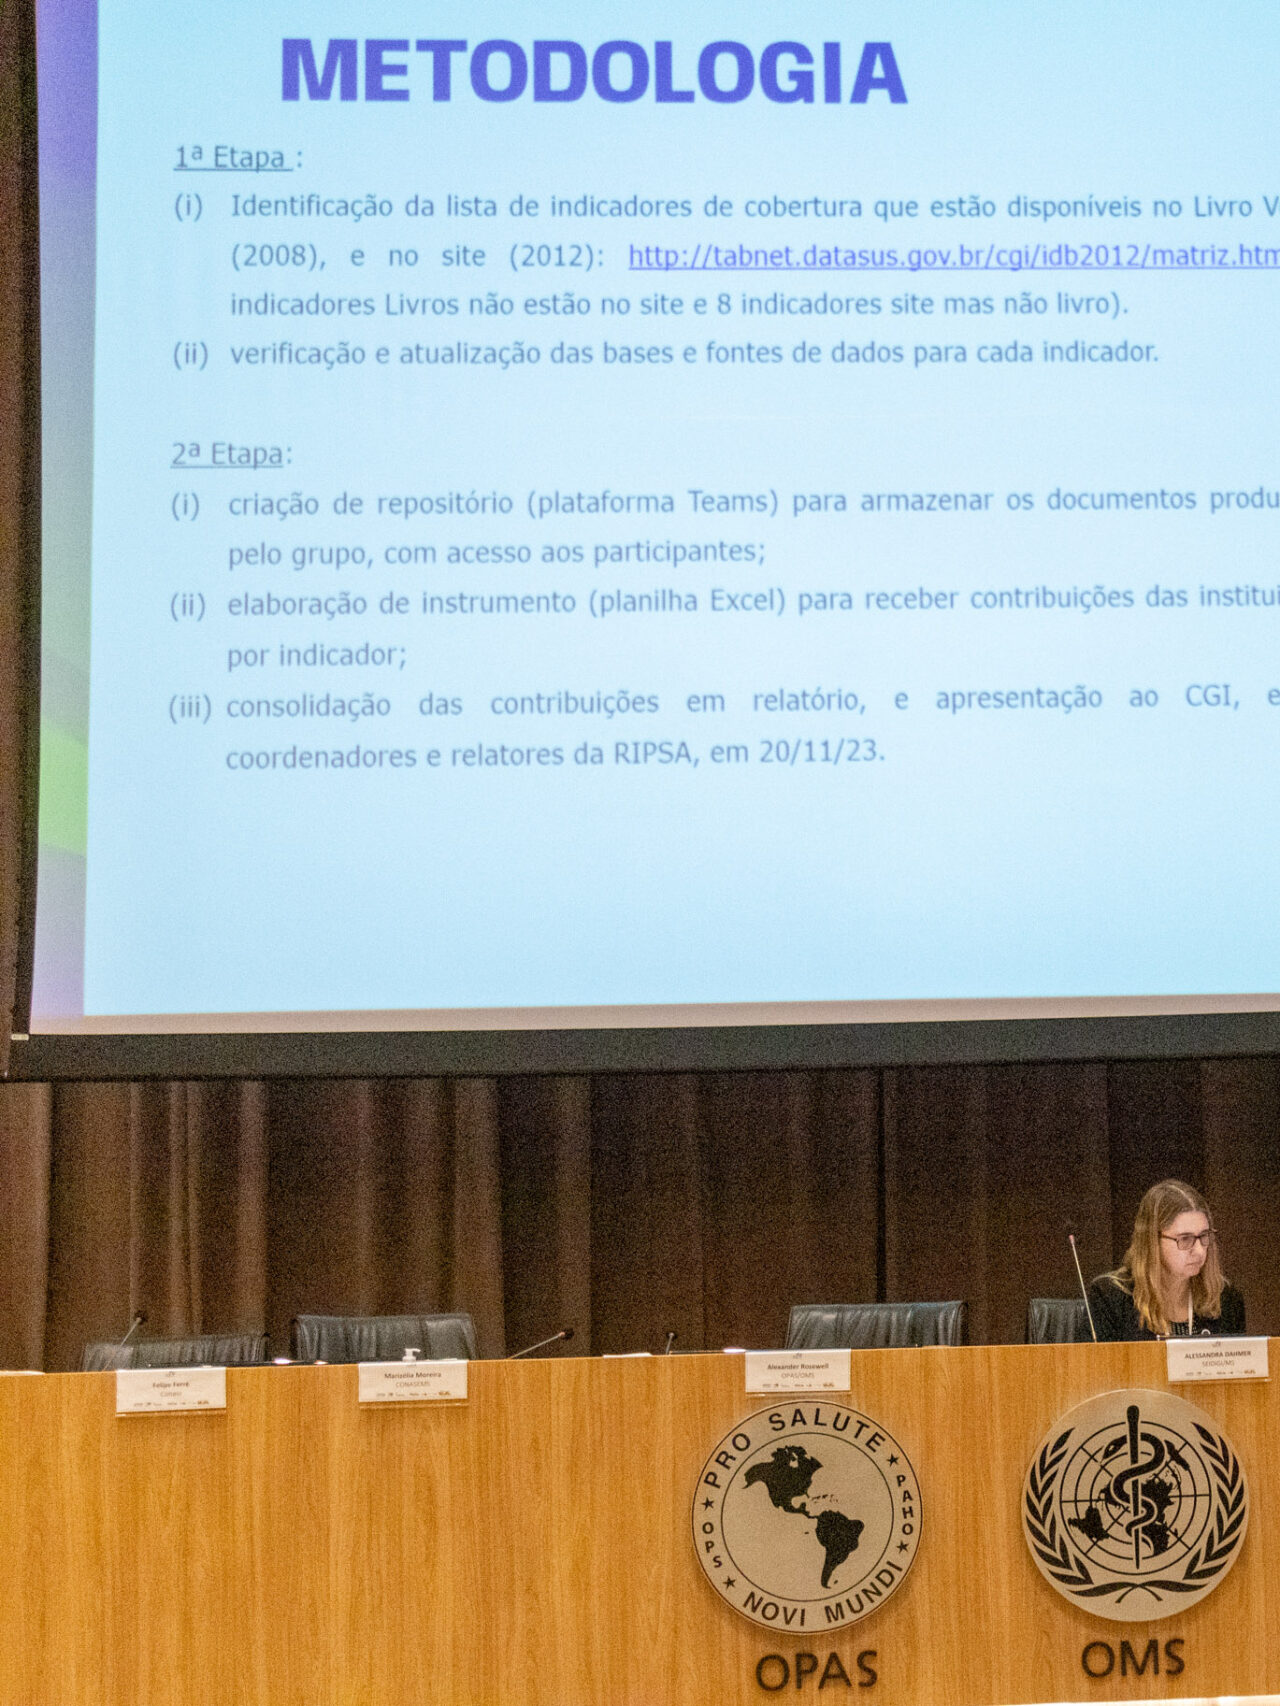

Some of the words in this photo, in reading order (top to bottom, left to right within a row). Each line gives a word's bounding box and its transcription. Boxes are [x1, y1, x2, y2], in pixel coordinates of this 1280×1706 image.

[281, 38, 909, 104] METODOLOGIA
[214, 144, 286, 174] Etapa
[174, 193, 203, 222] (i)
[232, 193, 393, 223] Identificação
[405, 194, 434, 217] da
[447, 194, 497, 217] lista
[509, 194, 539, 217] de
[551, 194, 692, 217] indicadores
[703, 195, 733, 217] de
[744, 195, 862, 217] cobertura
[874, 200, 919, 222] que
[930, 194, 996, 218] estão
[1007, 194, 1142, 222] disponíveis
[1153, 200, 1183, 217] no
[1194, 195, 1253, 218] Livro
[232, 244, 326, 271] (2008),
[350, 249, 365, 267] e
[389, 249, 419, 267] no
[442, 245, 486, 267] site
[510, 244, 603, 272] (2012):
[231, 292, 375, 315] indicadores
[386, 293, 459, 316] Livros
[469, 292, 514, 315] não
[524, 292, 591, 315] estão
[601, 298, 631, 315] no
[640, 293, 684, 315] site
[693, 298, 707, 315] e
[717, 293, 732, 315] 8
[742, 292, 882, 315] indicadores
[891, 293, 934, 314] site
[944, 297, 994, 314] mas
[1004, 291, 1048, 314] não
[1057, 291, 1128, 319] livro).
[173, 341, 208, 371] (ii)
[230, 341, 366, 370] verificação
[375, 347, 390, 364] e
[400, 341, 541, 370] atualização
[550, 341, 593, 364] das
[603, 341, 674, 364] bases
[682, 346, 697, 363] e
[706, 340, 783, 363] fontes
[792, 341, 822, 363] de
[831, 340, 904, 363] dados
[914, 345, 967, 368] para
[977, 340, 1033, 363] cada
[1043, 340, 1159, 362] indicador.
[211, 441, 293, 471] Etapa:
[171, 492, 199, 521] (i)
[229, 492, 319, 521] criação
[333, 491, 363, 515] de
[378, 490, 513, 519] repositório
[528, 489, 674, 519] (plataforma
[688, 489, 778, 517] Teams)
[793, 494, 847, 517] para
[860, 493, 994, 512] armazenar
[1006, 492, 1034, 511] os
[1046, 487, 1197, 510] documentos
[229, 542, 282, 571] pelo
[292, 547, 373, 571] grupo,
[384, 546, 436, 564] com
[447, 545, 531, 563] acesso
[541, 545, 584, 563] aos
[594, 540, 764, 568] participantes;
[170, 592, 205, 622] (ii)
[228, 592, 367, 620] elaboração
[379, 591, 409, 614] de
[423, 592, 576, 614] instrumento
[589, 589, 698, 618] (planilha
[711, 587, 786, 616] Excel)
[798, 592, 853, 616] para
[865, 586, 959, 610] receber
[970, 585, 1135, 614] contribuições
[1145, 584, 1188, 607] das
[228, 649, 269, 672] por
[280, 643, 405, 670] indicador;
[169, 694, 211, 724] (iii)
[227, 693, 391, 722] consolidação
[419, 692, 463, 716] das
[490, 689, 659, 719] contribuições
[686, 694, 725, 713] em
[753, 686, 866, 715] relatório,
[894, 691, 909, 710] e
[936, 684, 1103, 715] apresentação
[1129, 689, 1159, 707] ao
[1185, 683, 1240, 710] CGI,
[226, 745, 417, 770] coordenadores
[426, 749, 441, 767] e
[452, 743, 564, 767] relatores
[573, 742, 604, 765] da
[615, 741, 699, 768] RIPSA,
[710, 745, 749, 763] em
[760, 738, 885, 766] 20/11/23.
[767, 1363, 799, 1371] Alexander
[1184, 1351, 1224, 1360] ALESSANDRA
[703, 1432, 751, 1489] PRO
[768, 1407, 887, 1453] SALUTE
[896, 1474, 914, 1536] PAHO
[702, 1521, 723, 1569] OPS
[742, 1591, 806, 1627] NOVI
[824, 1560, 904, 1624] MUNDI
[755, 1650, 878, 1692] OPAS
[1080, 1638, 1186, 1679] OMS
